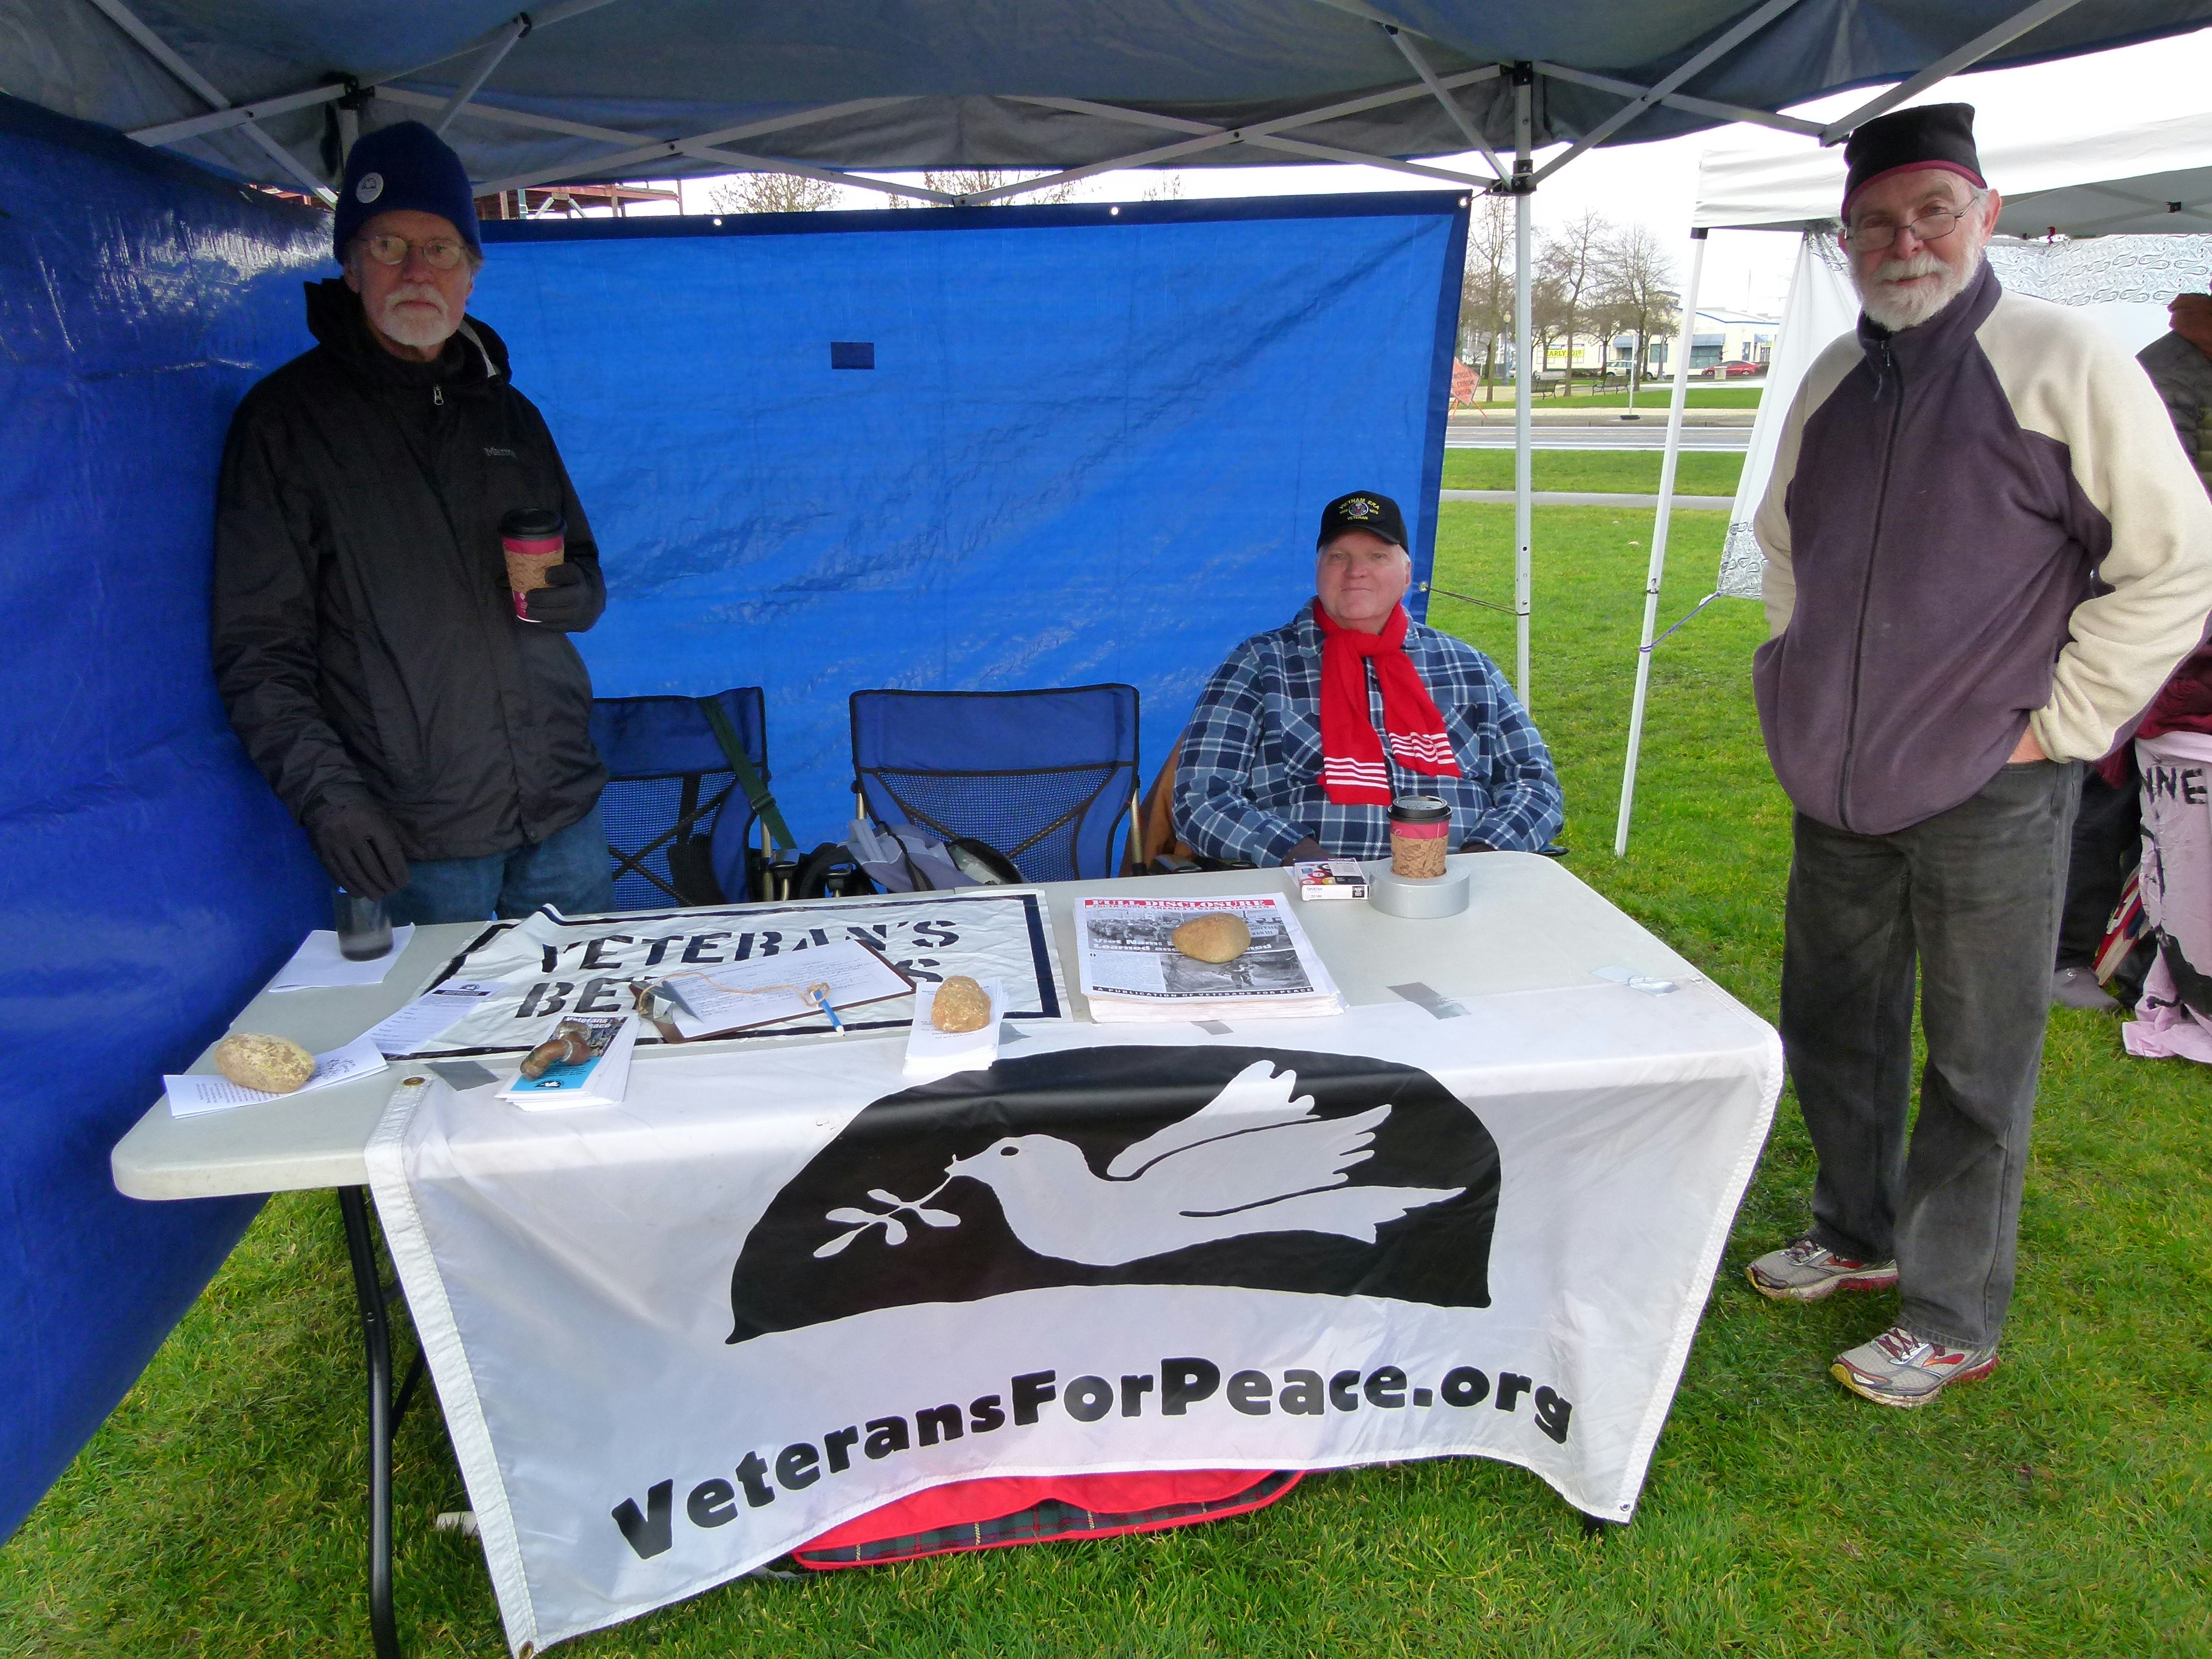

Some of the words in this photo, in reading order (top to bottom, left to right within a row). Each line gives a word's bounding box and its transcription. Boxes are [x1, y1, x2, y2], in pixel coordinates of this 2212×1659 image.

[1339, 498, 1366, 509] VIETNAM
[1368, 500, 1380, 510] ERA
[1145, 900, 1265, 908] DISCLOSURE
[1108, 988, 1177, 997] PUBLICATION
[611, 1357, 1572, 1559] VeteransForPeace.org
